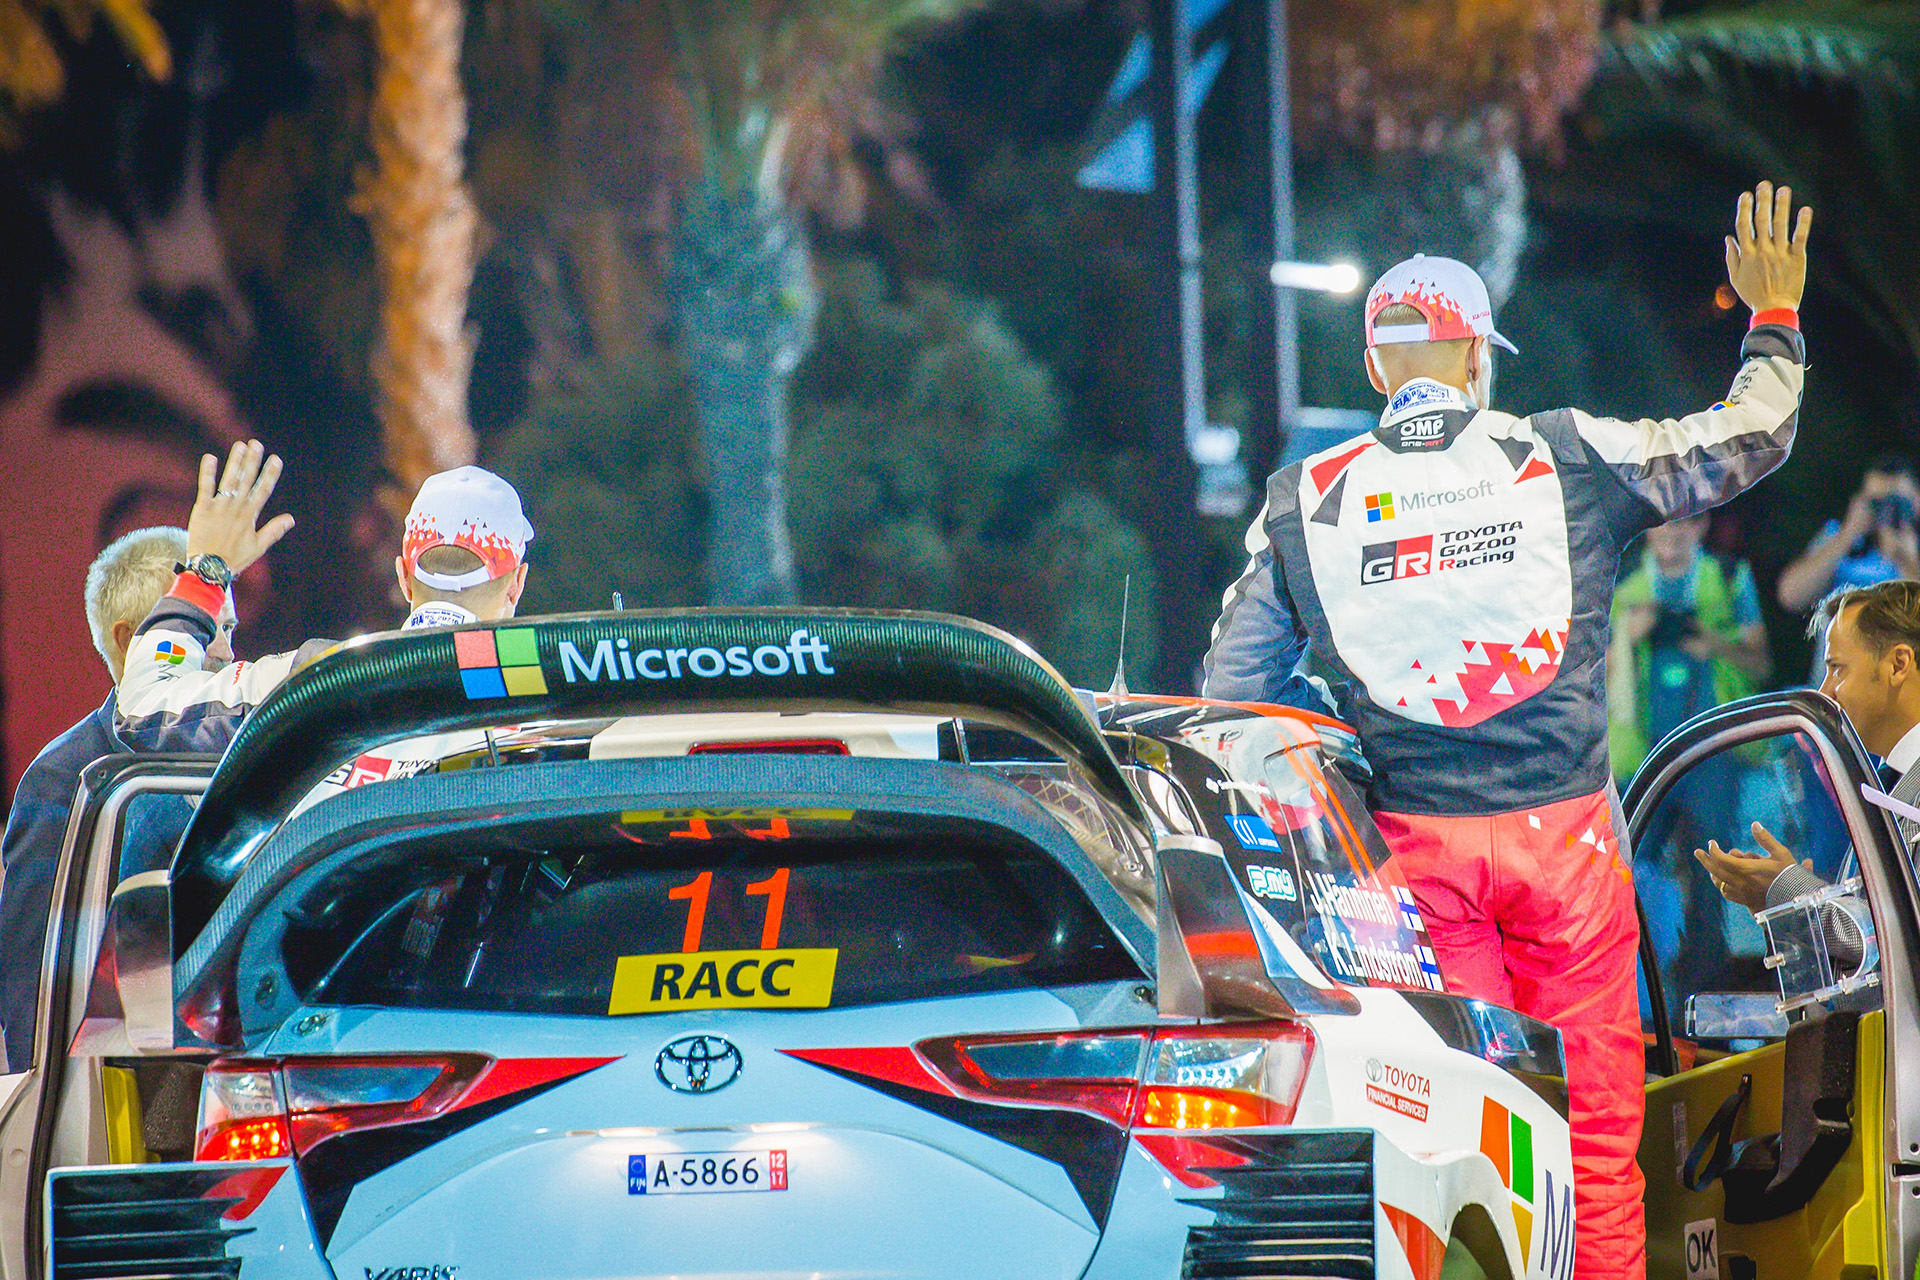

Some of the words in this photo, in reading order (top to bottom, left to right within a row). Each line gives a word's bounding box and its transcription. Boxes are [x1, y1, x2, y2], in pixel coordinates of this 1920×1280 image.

[1400, 418, 1444, 436] OMP
[1400, 480, 1495, 511] Microsoft
[1440, 520, 1523, 543] TOYOTA
[1440, 535, 1516, 557] GAZOO
[1361, 550, 1430, 584] GR
[1439, 550, 1515, 570] Racing
[558, 629, 834, 683] Microsoft
[668, 867, 790, 954] 11
[650, 959, 795, 1002] RACC
[1384, 1064, 1430, 1098] TOYOTA
[1397, 1098, 1427, 1120] SERVICES
[653, 1157, 759, 1188] A-5866
[770, 1153, 785, 1169] 12
[630, 1177, 646, 1188] FIN
[770, 1172, 784, 1186] 17
[1686, 1229, 1717, 1274] OK
